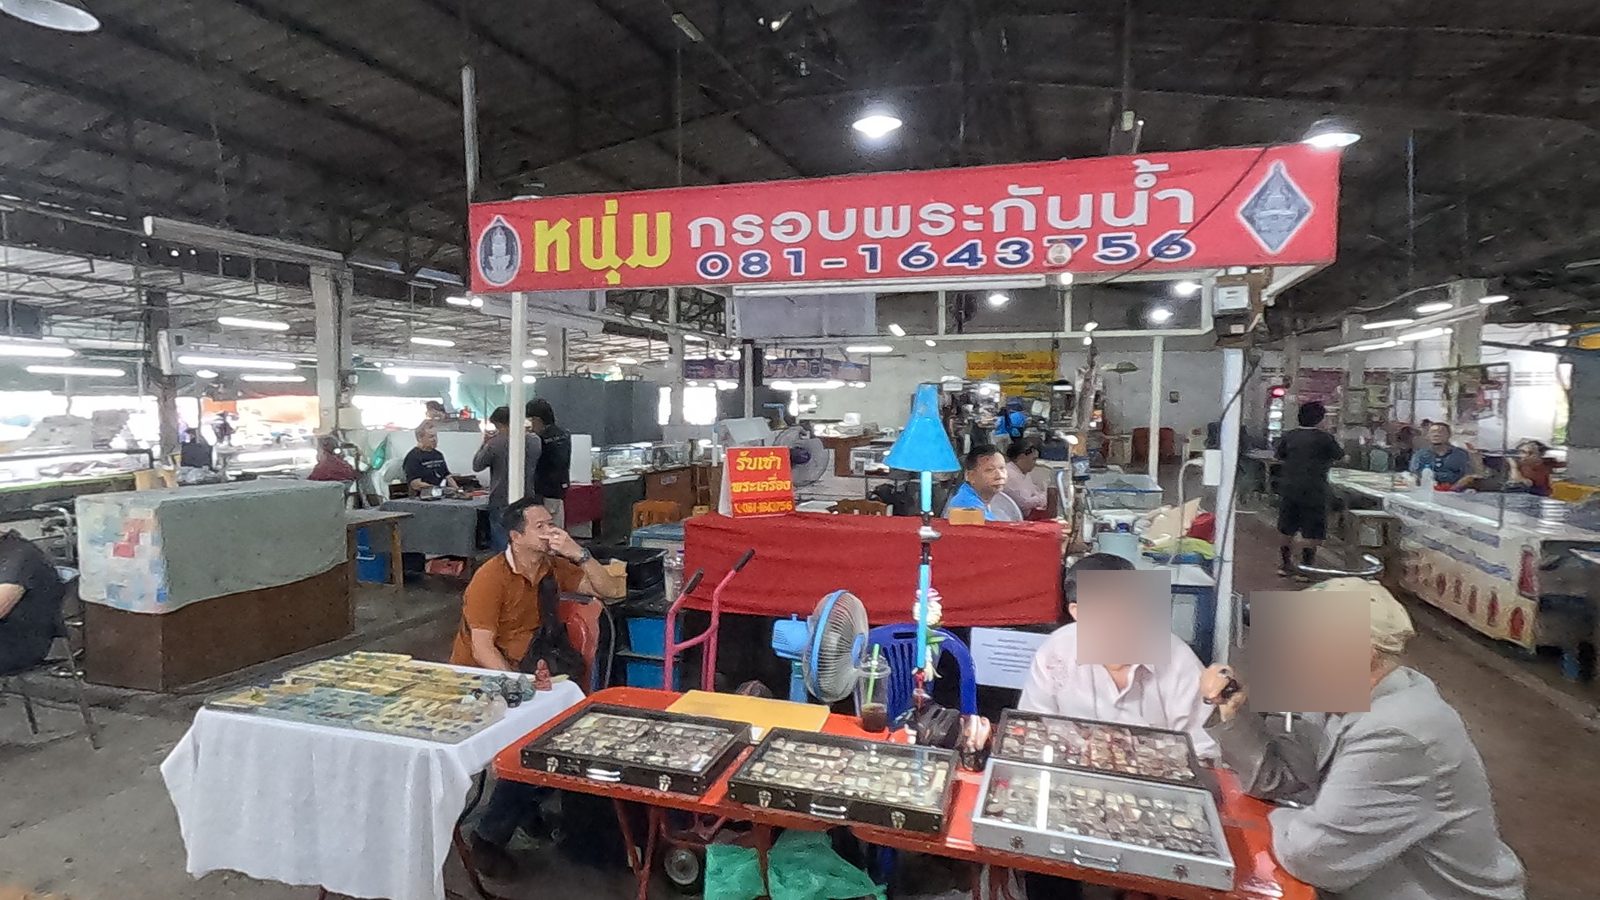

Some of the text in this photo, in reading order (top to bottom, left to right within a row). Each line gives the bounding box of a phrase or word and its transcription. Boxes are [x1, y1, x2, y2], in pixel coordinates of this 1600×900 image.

[533, 158, 1195, 286] หนุ่ม กรอบพระกันน้ำ
[735, 450, 782, 471] รับเช่า
[731, 473, 791, 493] พระเครื่อง
